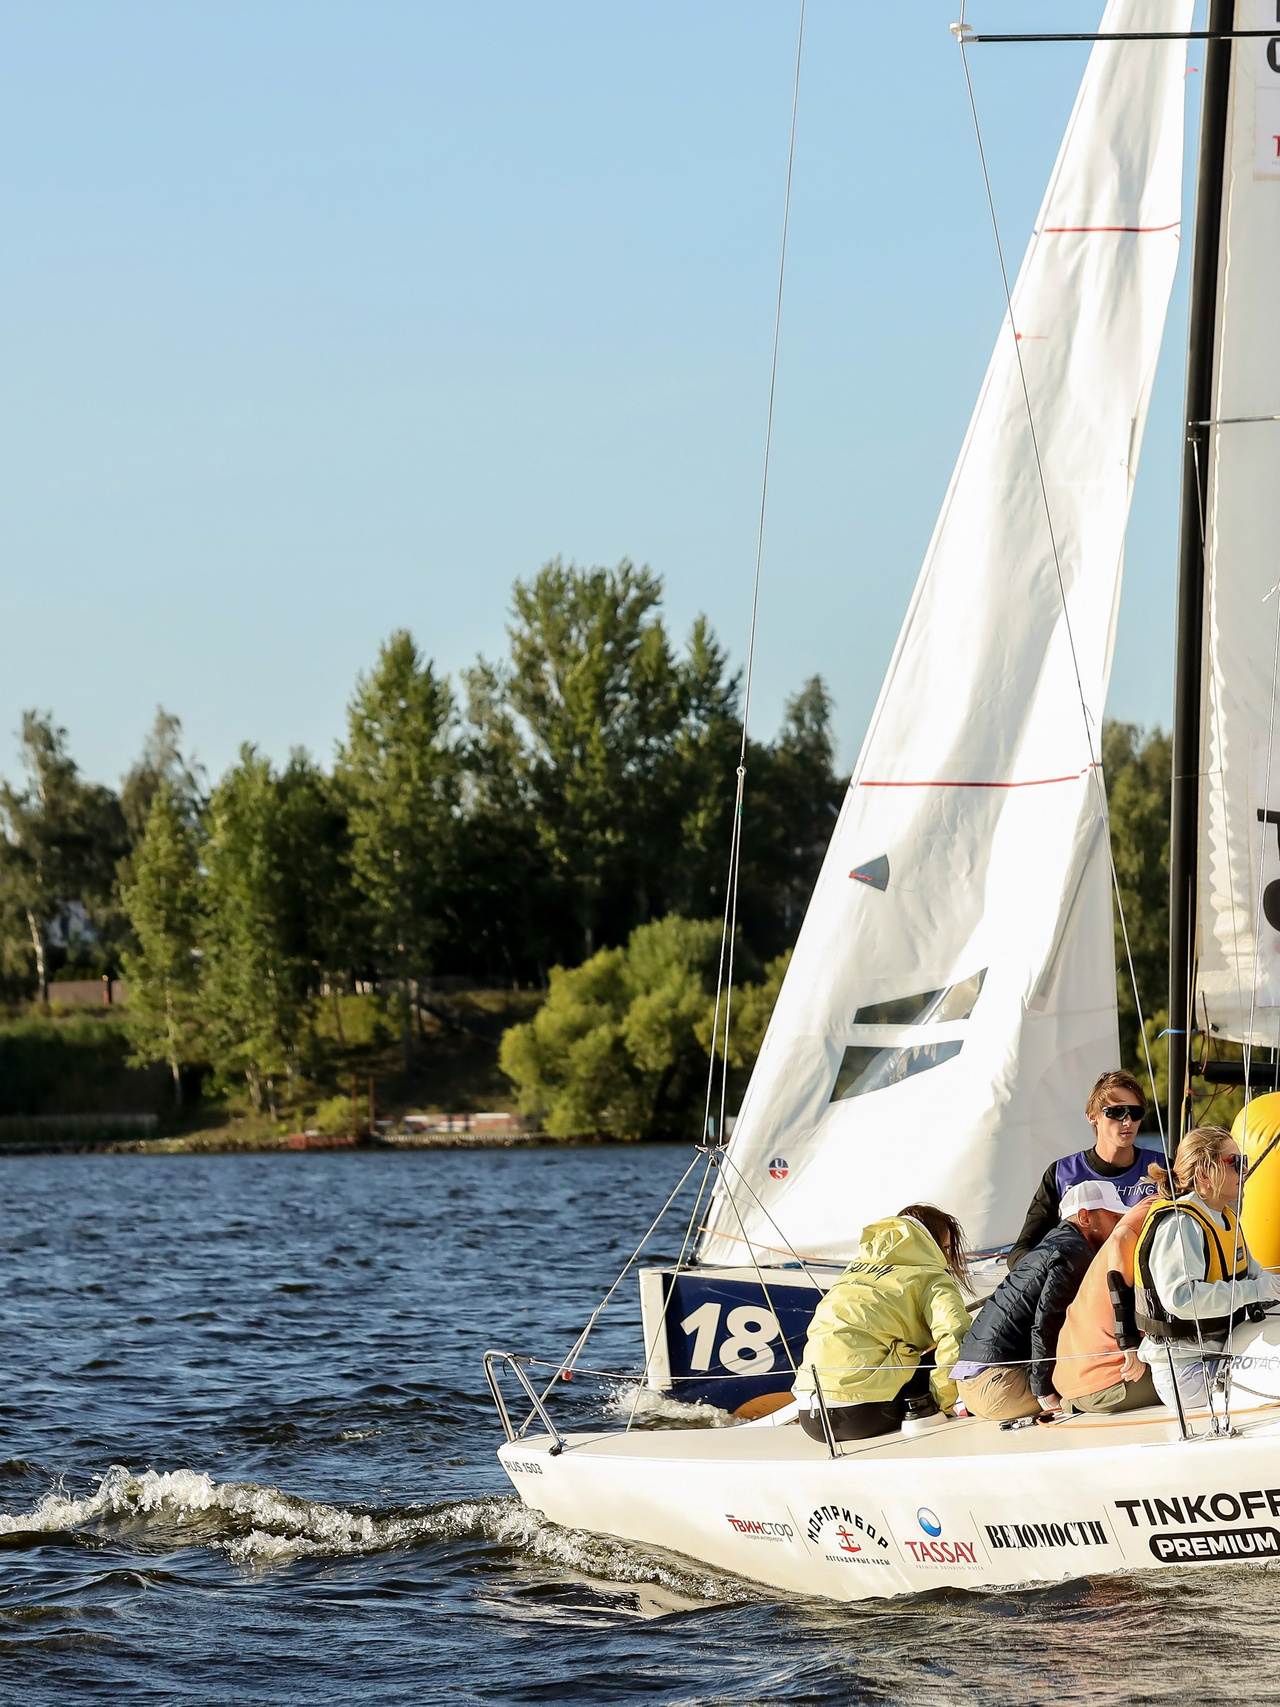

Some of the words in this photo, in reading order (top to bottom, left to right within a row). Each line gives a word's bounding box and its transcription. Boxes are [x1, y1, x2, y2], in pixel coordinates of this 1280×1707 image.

[680, 1302, 779, 1375] 18
[503, 1460, 523, 1472] RUS
[984, 1520, 1109, 1552] ВЕДОМОСТИ
[1156, 1531, 1279, 1559] PREMIUM
[904, 1541, 978, 1563] TASSAY
